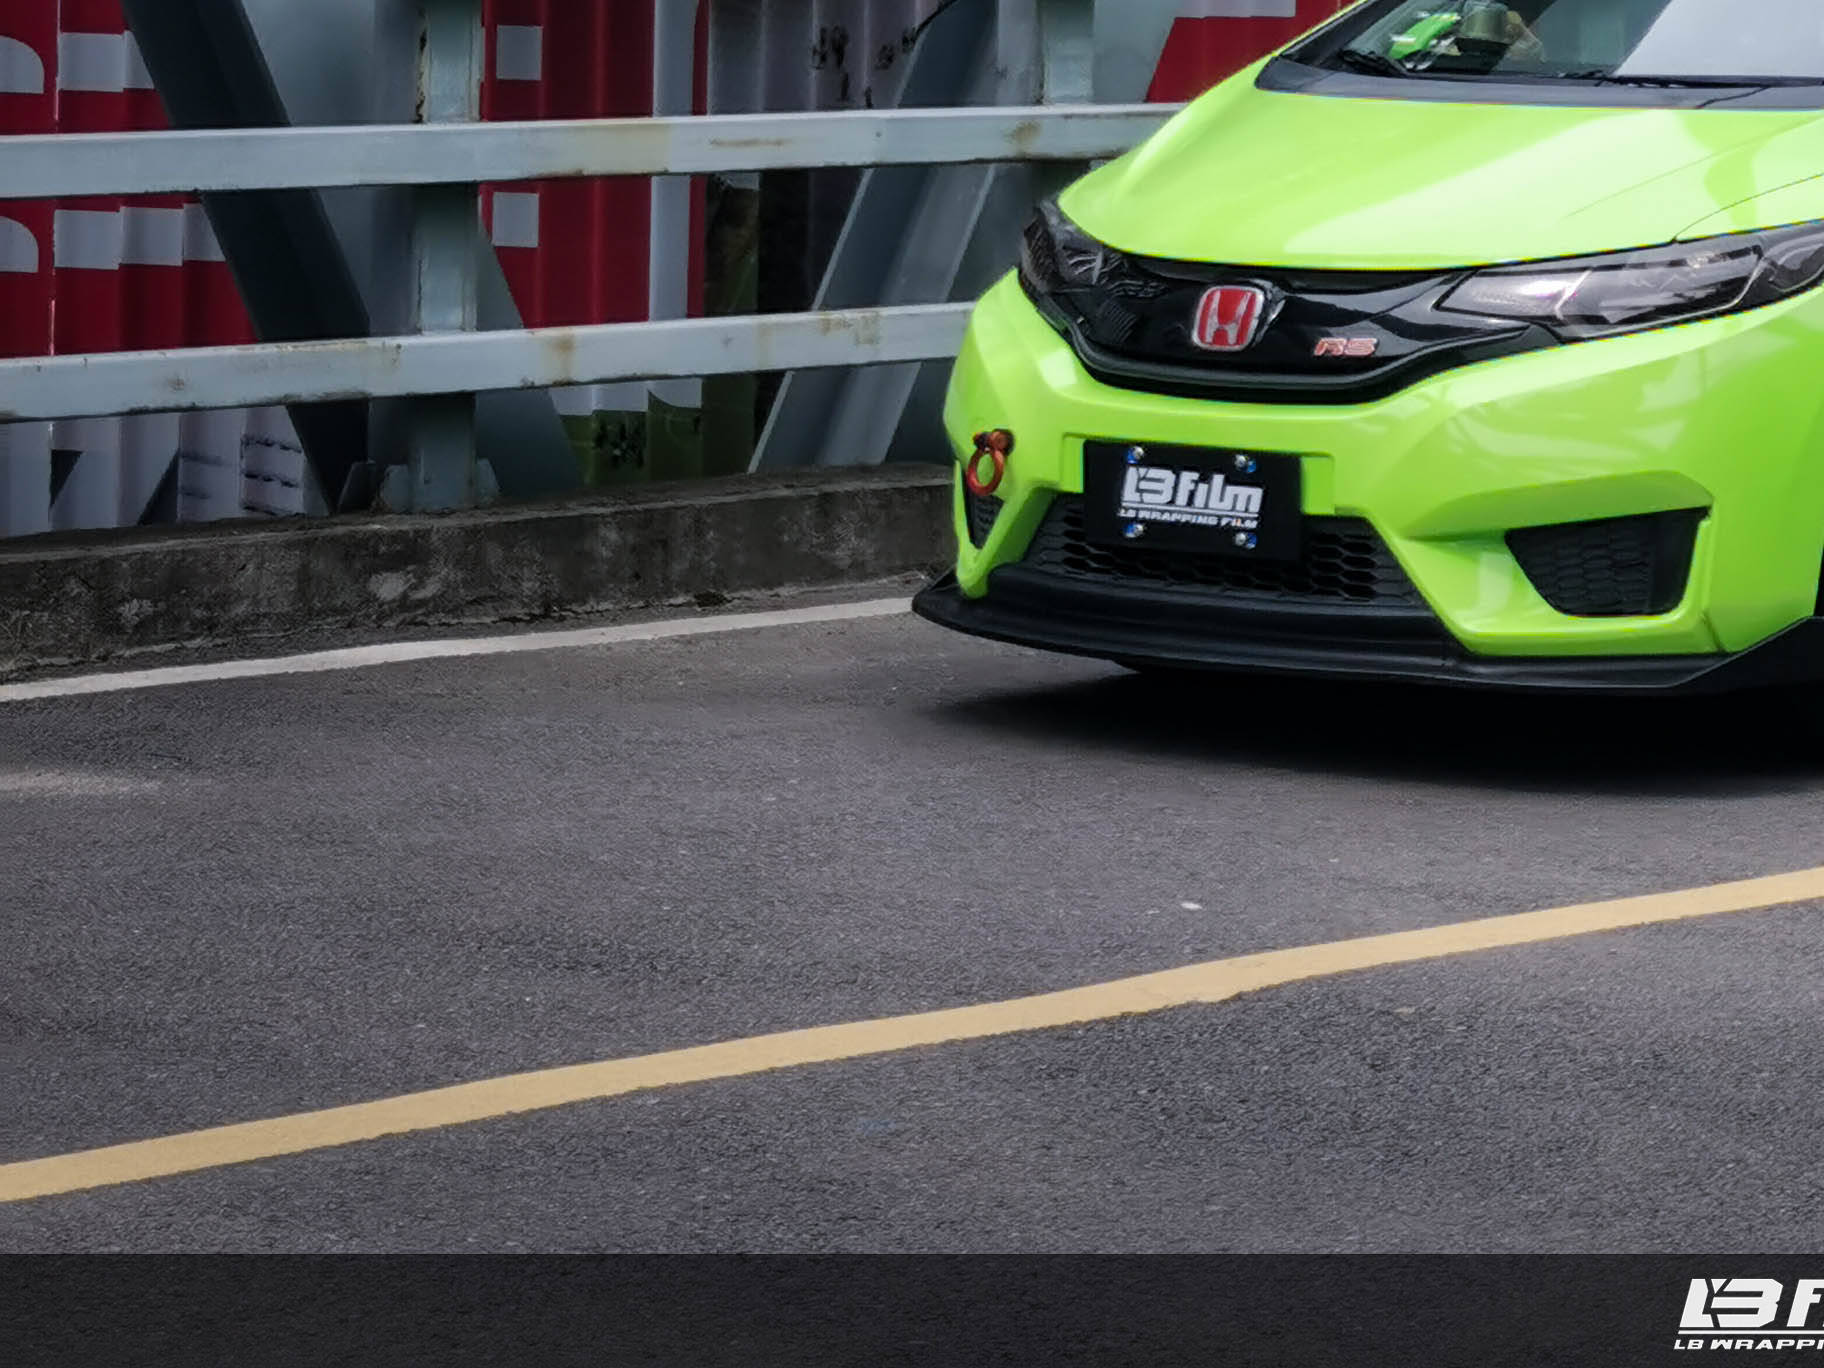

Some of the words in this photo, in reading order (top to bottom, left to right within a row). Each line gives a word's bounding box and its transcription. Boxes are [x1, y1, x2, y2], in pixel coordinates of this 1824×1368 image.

[1314, 337, 1377, 356] RS
[1138, 510, 1219, 526] WRAPPING
[1220, 517, 1259, 529] FILM
